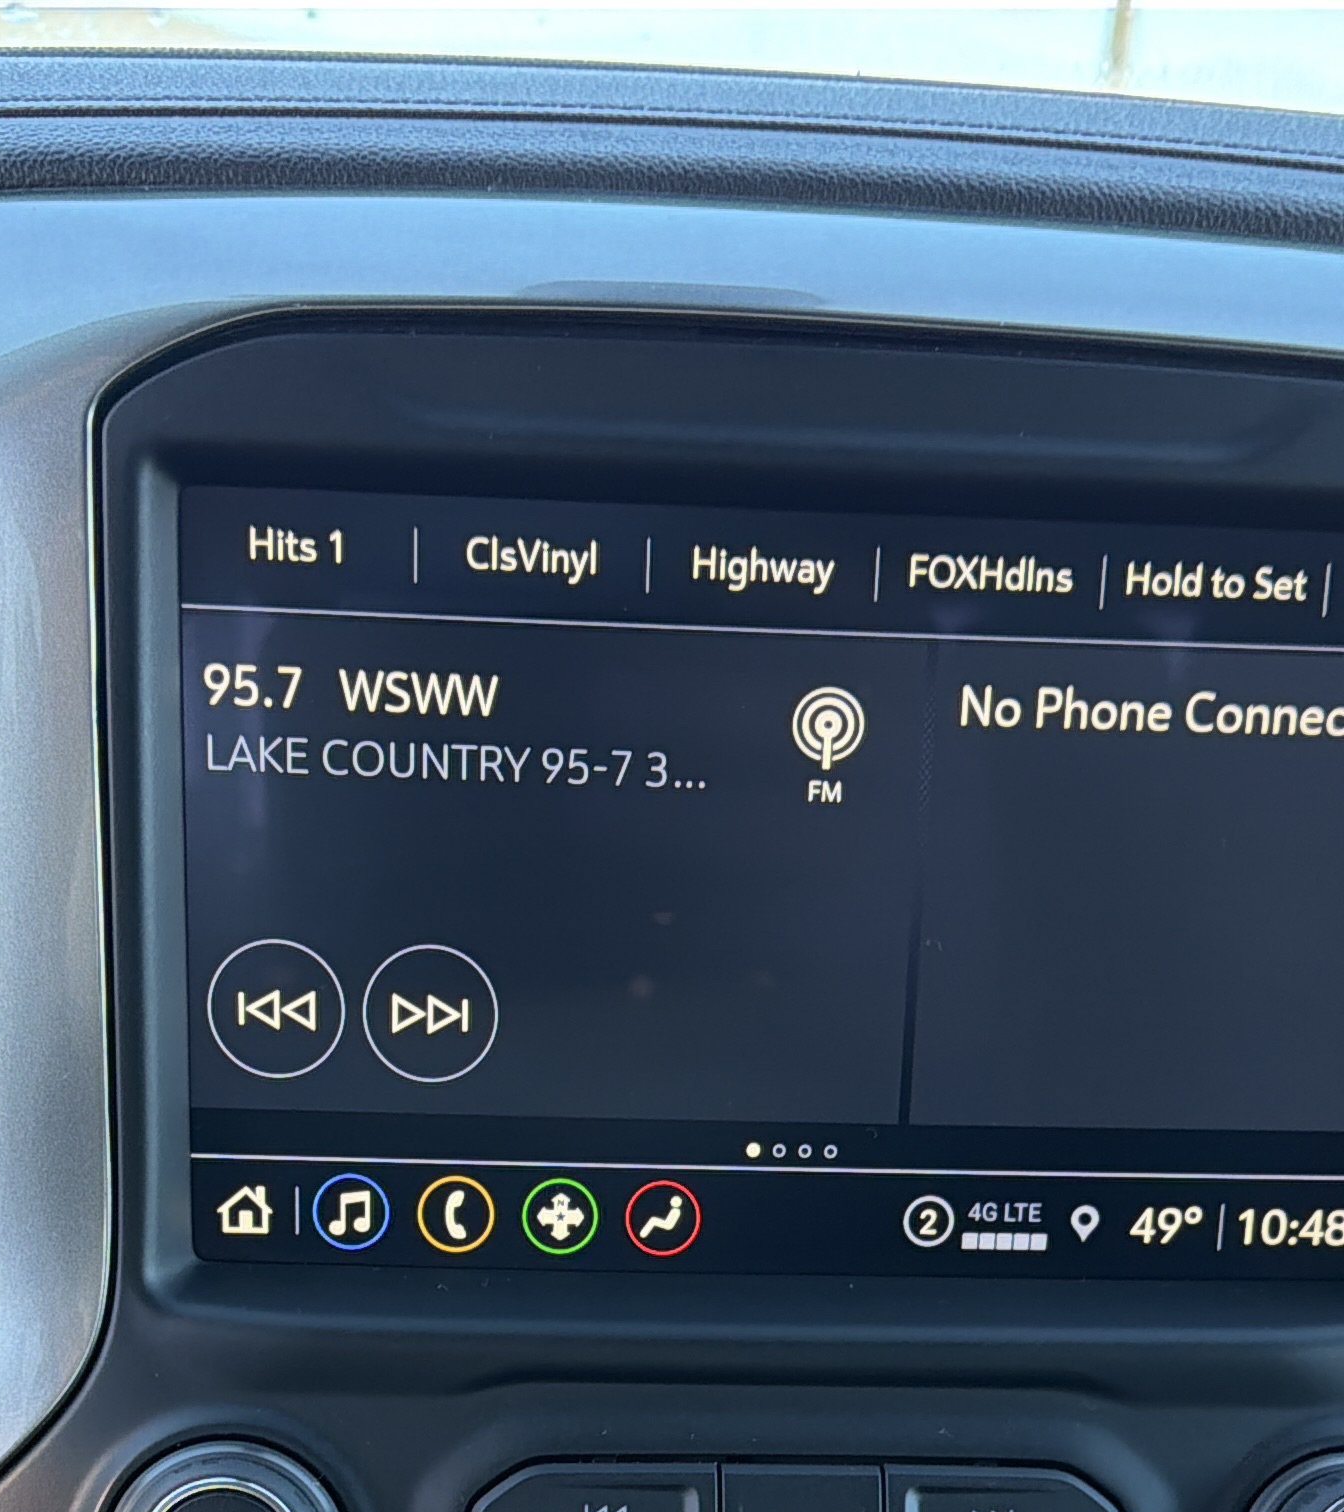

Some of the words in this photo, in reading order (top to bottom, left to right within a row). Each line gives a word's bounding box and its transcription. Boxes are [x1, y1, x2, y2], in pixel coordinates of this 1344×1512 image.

[249, 525, 318, 563] Hits
[329, 529, 342, 564] 1
[692, 544, 836, 595] Highway
[1125, 561, 1204, 598] Hold
[1210, 566, 1246, 599] to
[1252, 566, 1308, 602] Set
[203, 662, 303, 709] 95.7
[338, 668, 499, 717] WSWW
[960, 684, 1022, 728] No
[1035, 684, 1173, 732] Phone
[206, 733, 309, 775] LAKE
[322, 739, 531, 783] COUNTRY
[541, 747, 633, 787] 95-7
[807, 779, 842, 804] FM
[919, 1208, 938, 1236] 2
[967, 1201, 998, 1222] 4G
[1003, 1202, 1043, 1223] LTE
[1129, 1205, 1203, 1245] 49°
